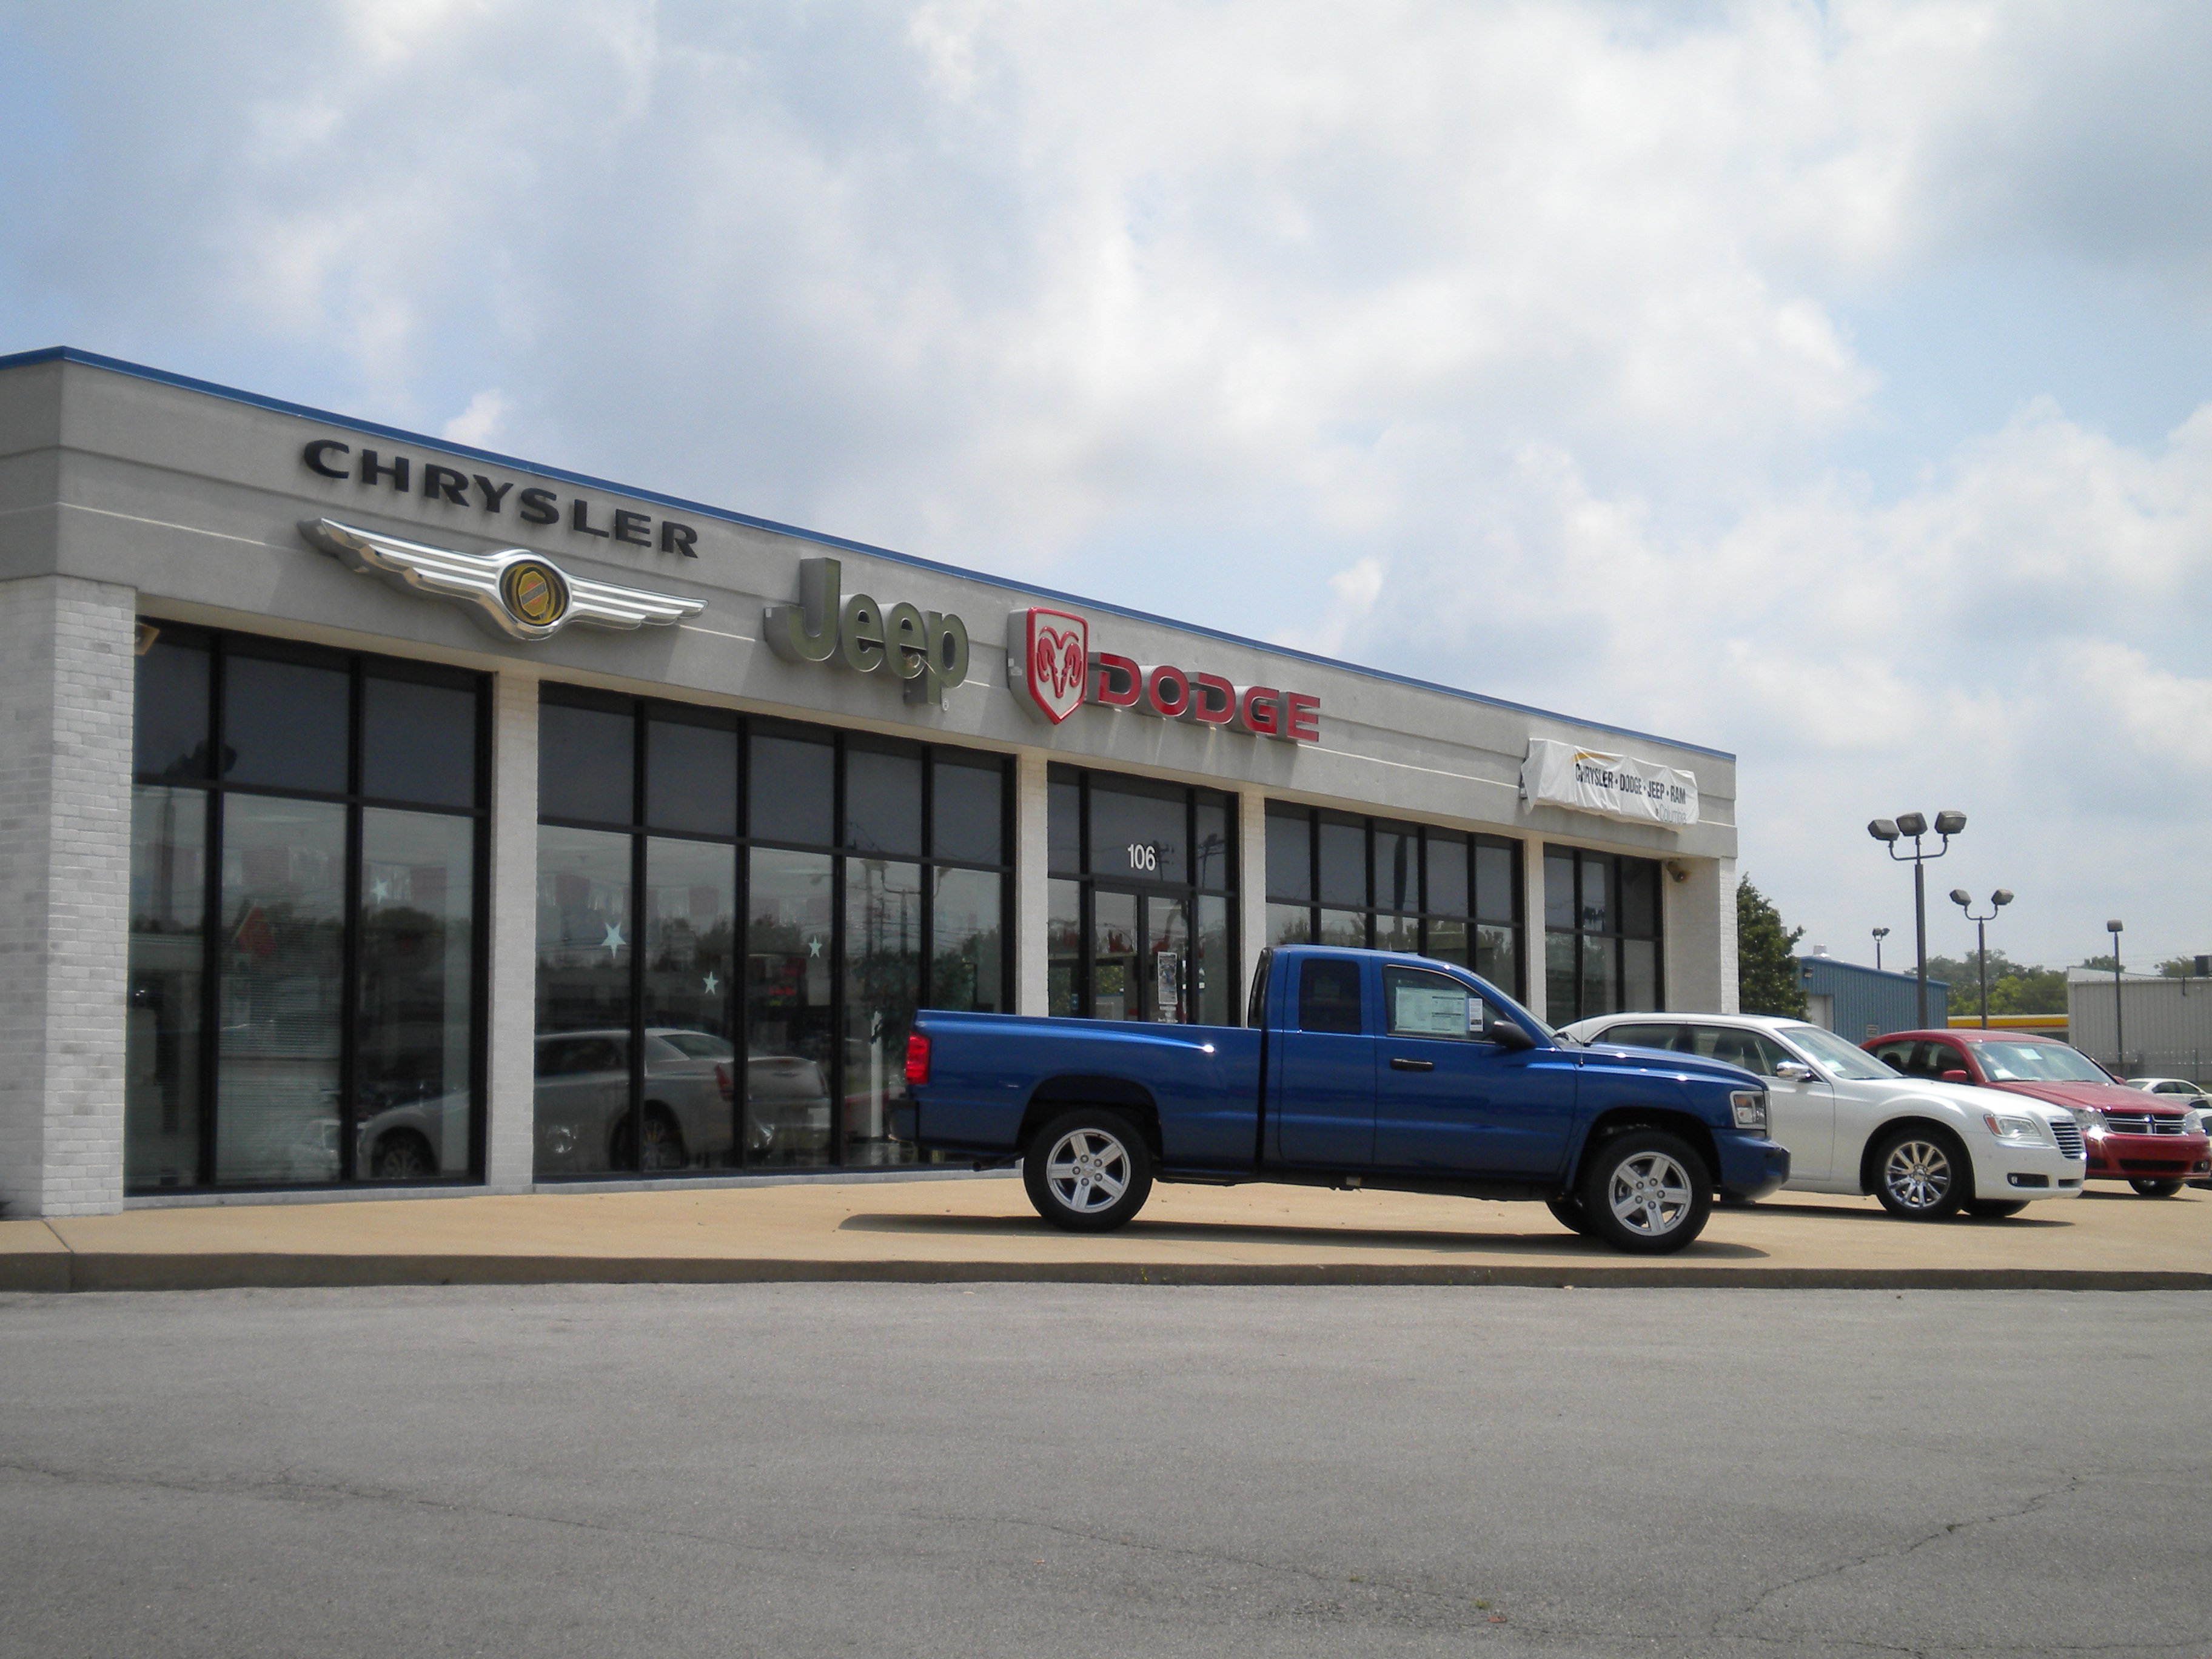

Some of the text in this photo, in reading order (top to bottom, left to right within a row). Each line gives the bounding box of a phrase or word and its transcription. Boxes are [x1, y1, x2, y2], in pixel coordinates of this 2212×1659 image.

[303, 439, 699, 558] CHRYSLER
[765, 557, 970, 705] Jeep
[1095, 652, 1320, 742] DODGE
[1576, 763, 1686, 805] CHRYSLER DODGE JEEP RAM
[1127, 843, 1156, 871] 106
